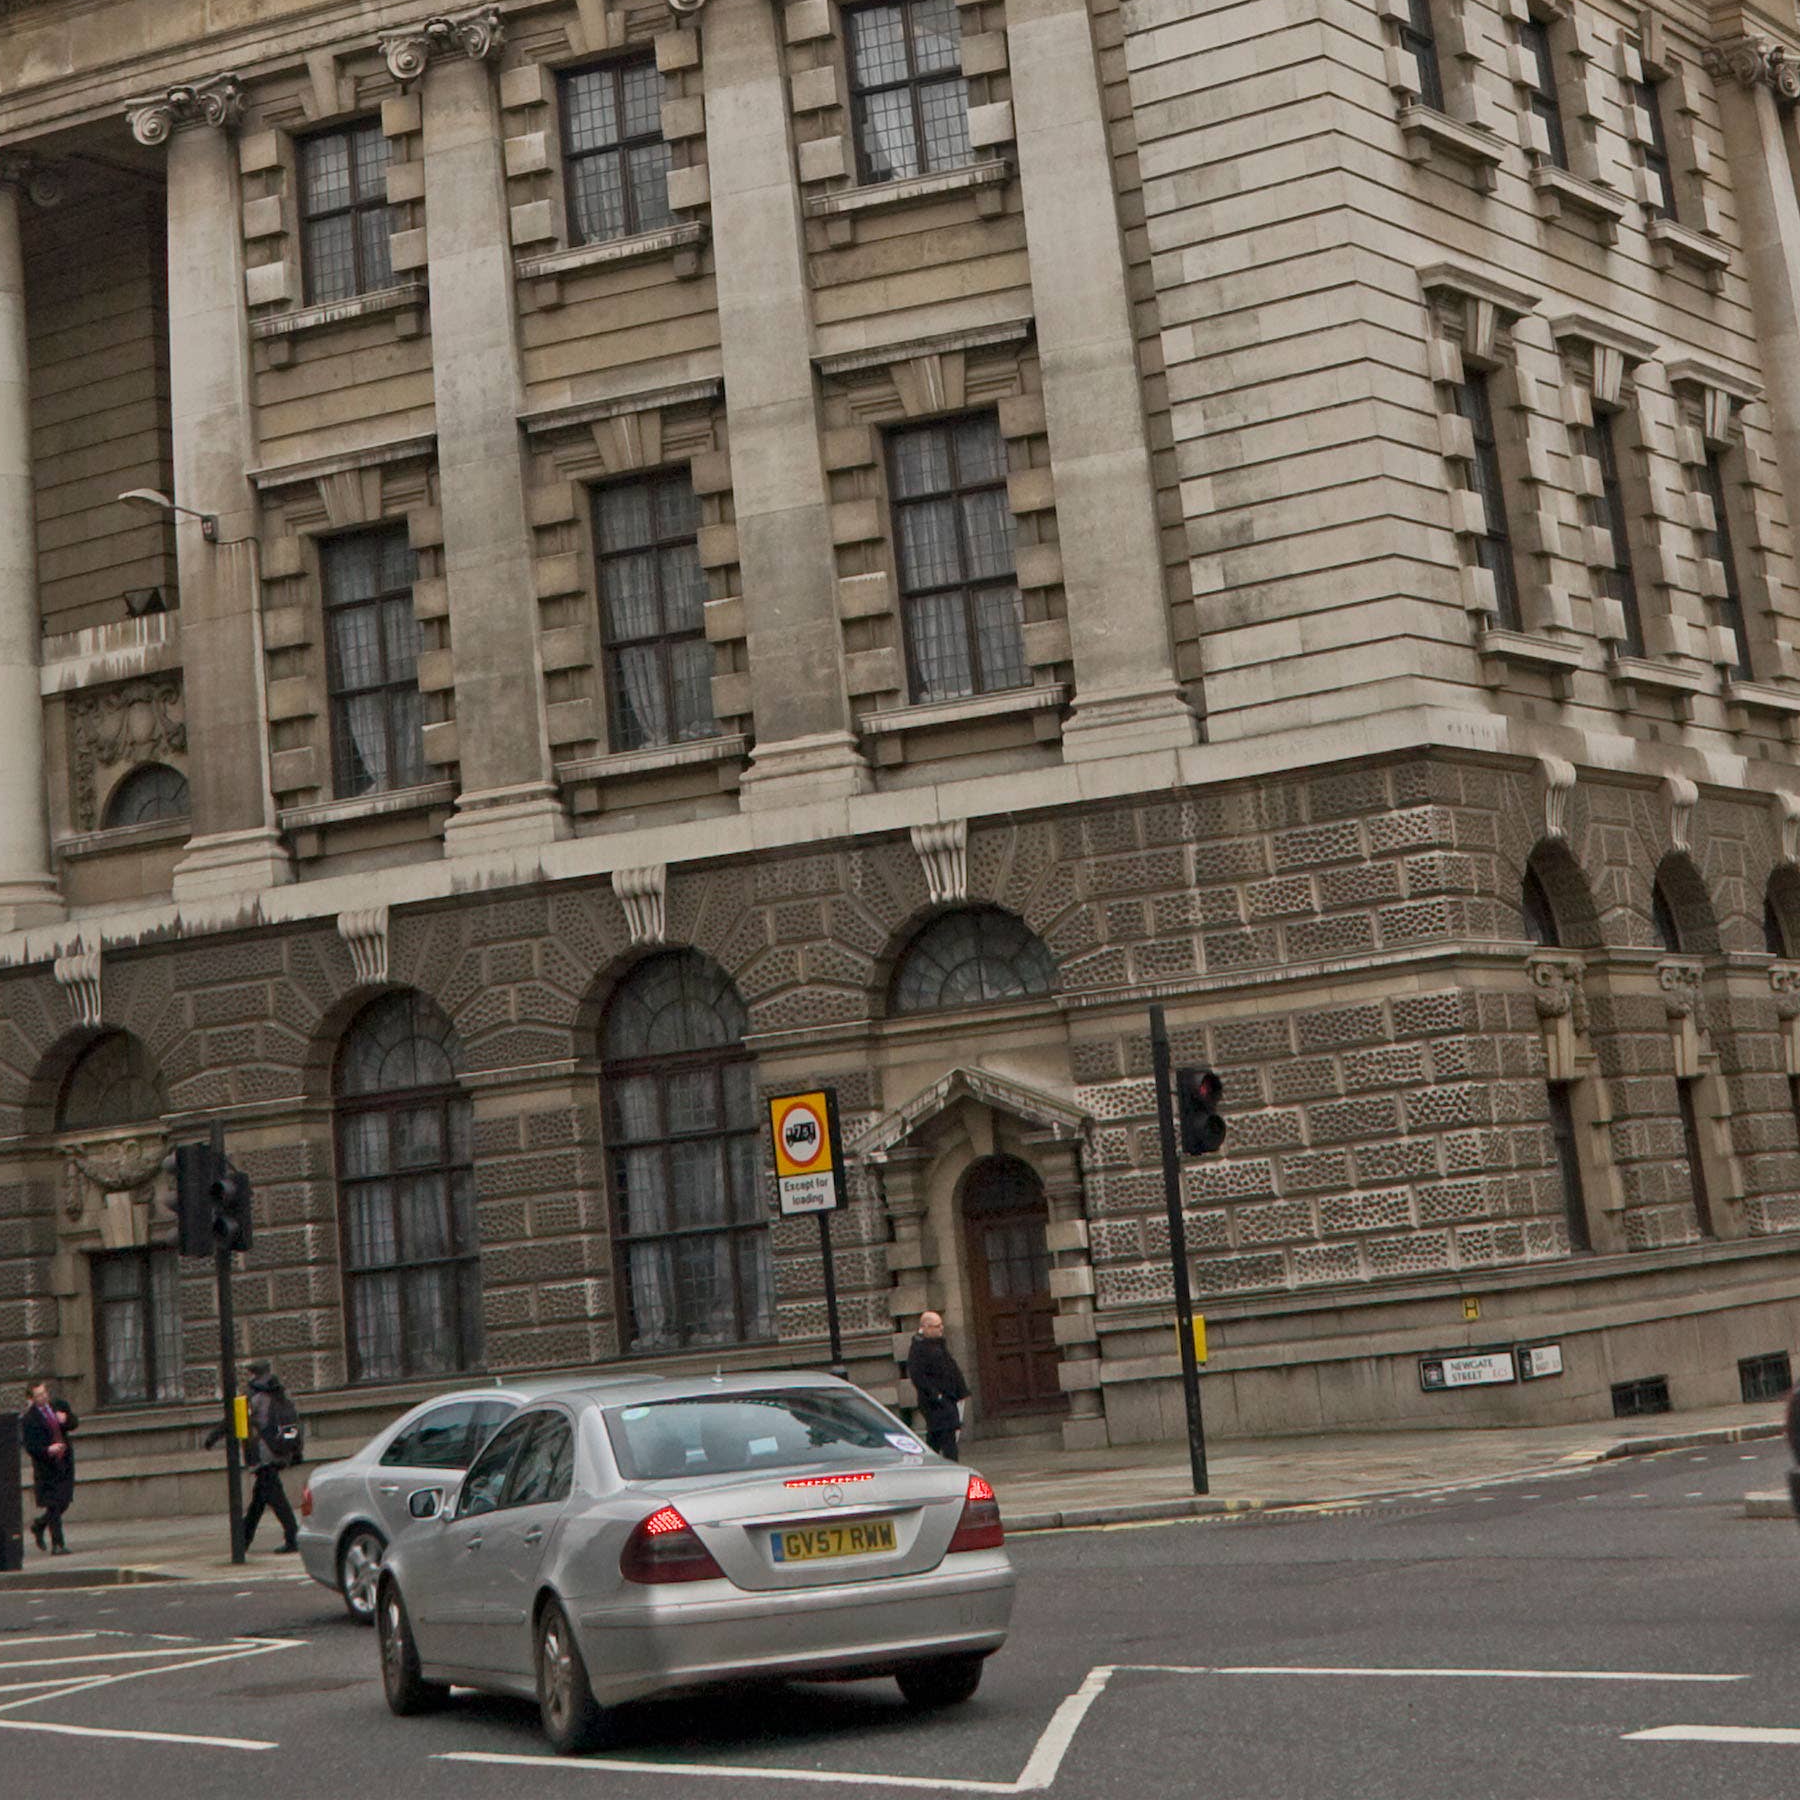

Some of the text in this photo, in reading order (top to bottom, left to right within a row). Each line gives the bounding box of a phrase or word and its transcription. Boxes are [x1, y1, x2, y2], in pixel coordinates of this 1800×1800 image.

[783, 1177, 828, 1192] Except for
[792, 1193, 824, 1205] loading
[1450, 1358, 1494, 1371] NEWGATE
[1451, 1370, 1483, 1382] STREET
[786, 1523, 892, 1557] GV57 RWW
